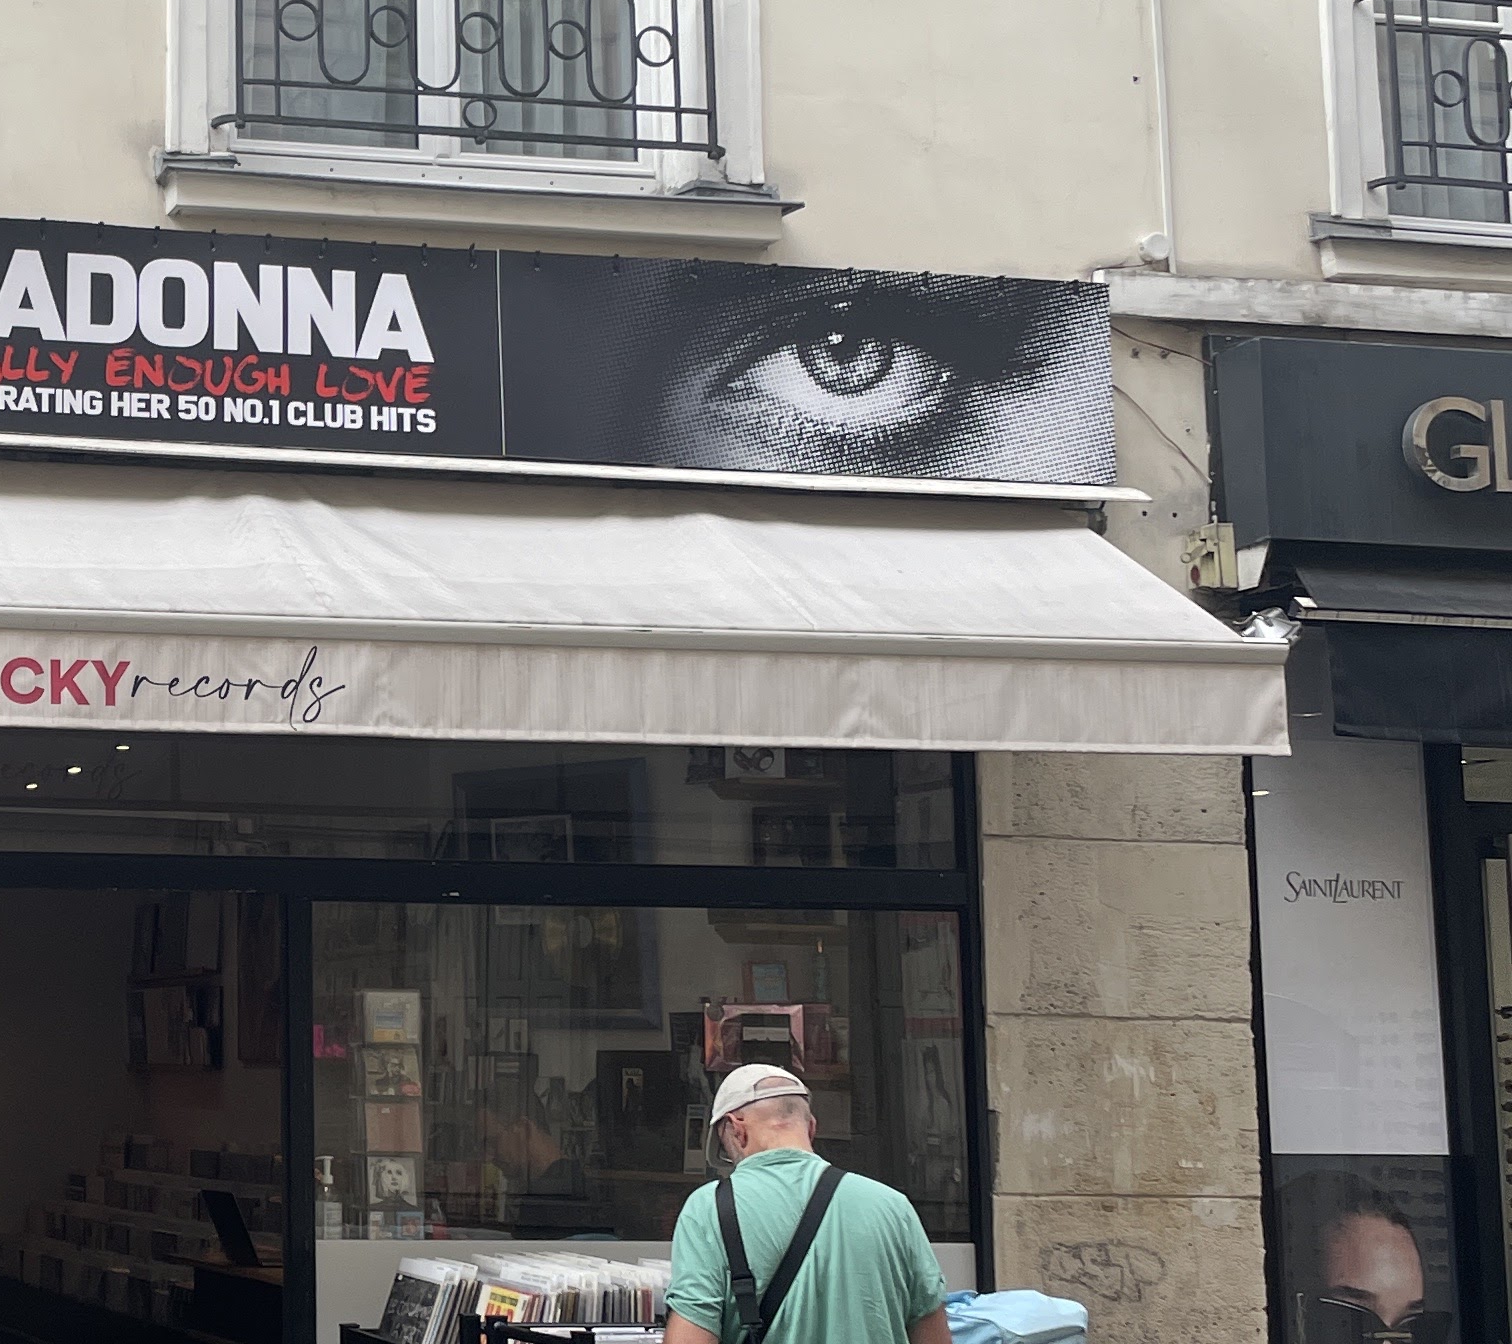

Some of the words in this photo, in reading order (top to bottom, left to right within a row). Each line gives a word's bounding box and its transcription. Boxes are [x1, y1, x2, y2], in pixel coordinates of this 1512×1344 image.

[105, 348, 290, 396] ENOUGH
[315, 361, 433, 405] LOVE
[110, 390, 171, 420] HER
[177, 394, 215, 422] 50
[222, 396, 281, 426] NO.1
[287, 400, 363, 430] CLUB
[369, 405, 437, 434] HITS
[131, 646, 346, 731] records
